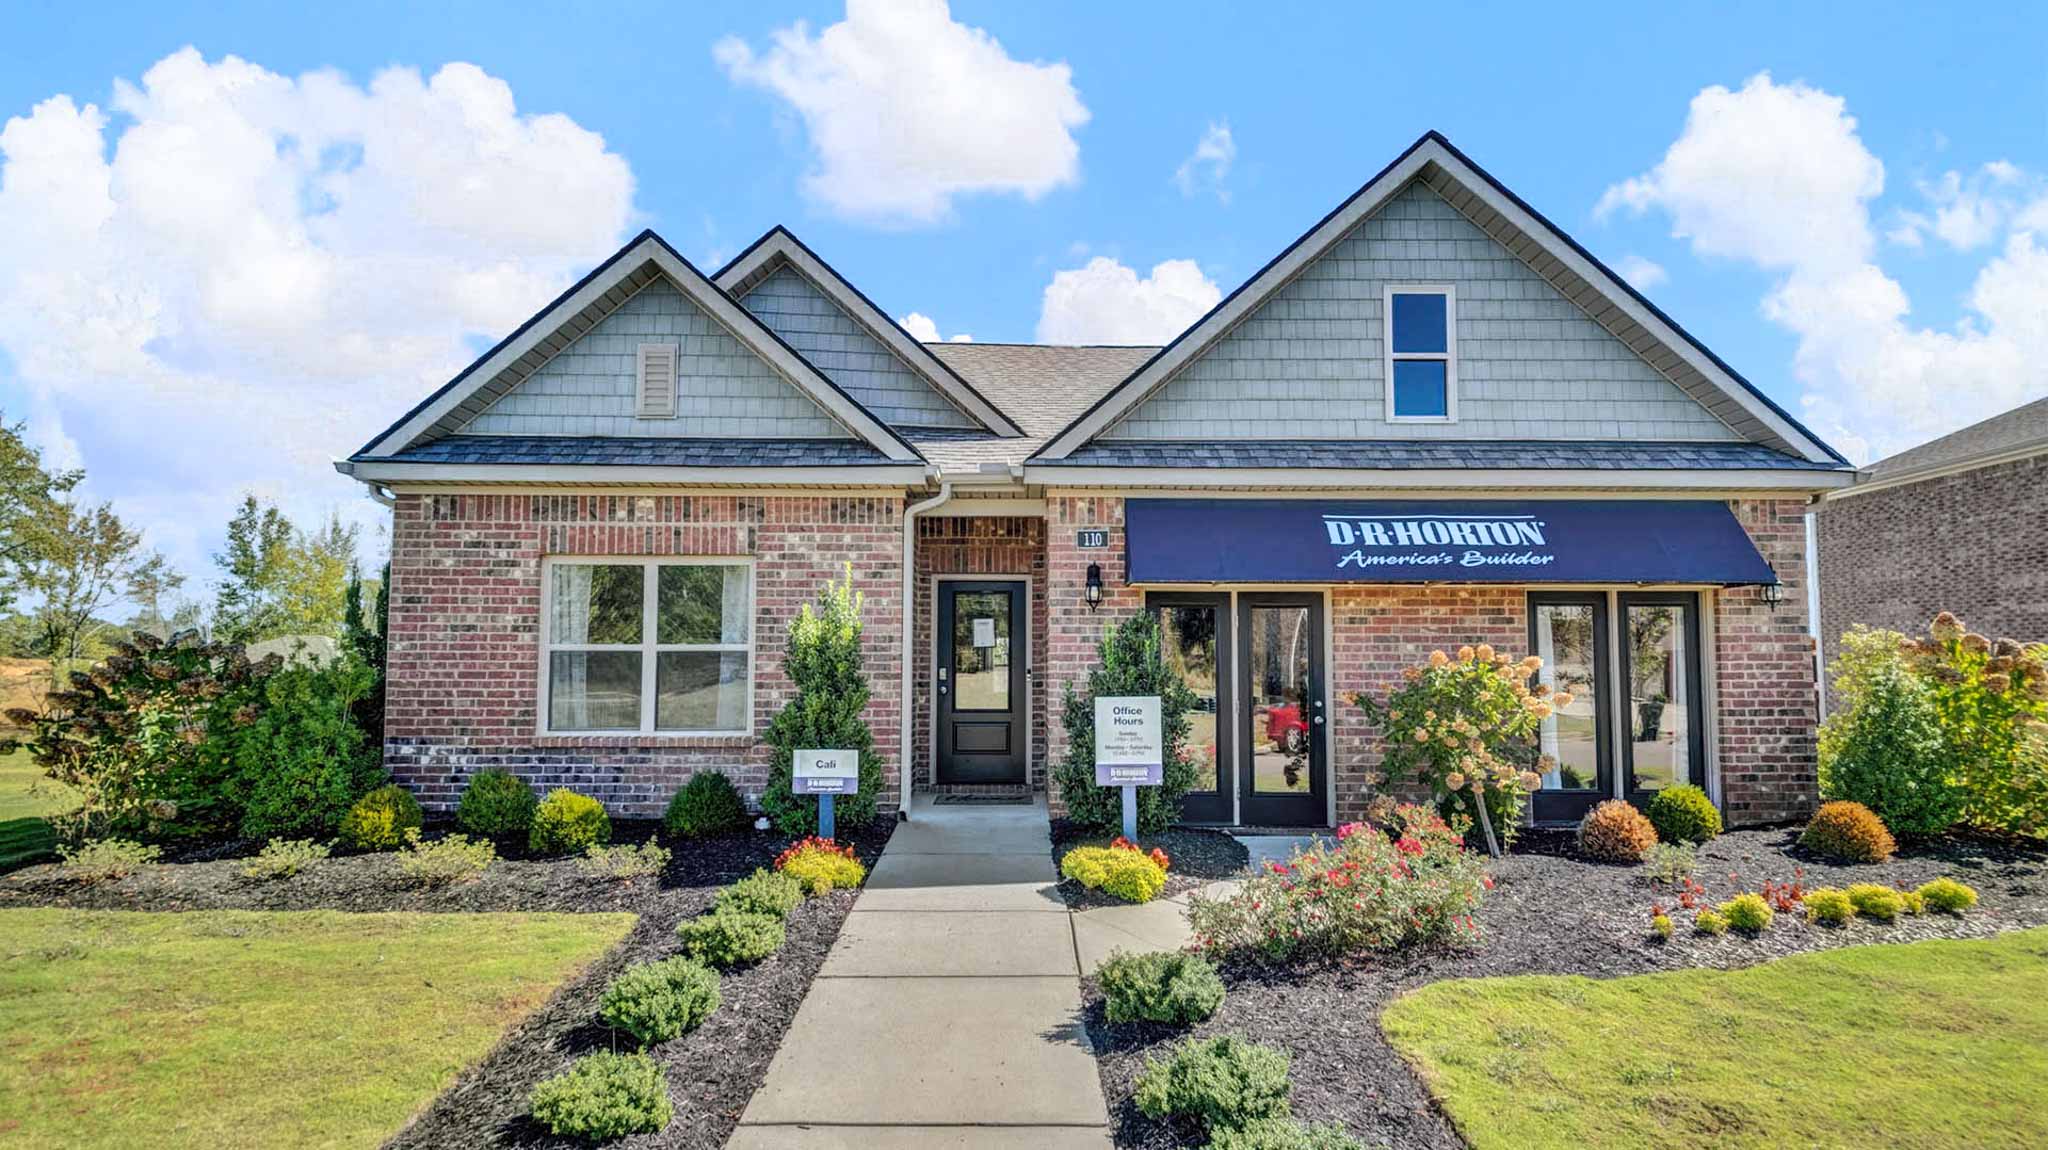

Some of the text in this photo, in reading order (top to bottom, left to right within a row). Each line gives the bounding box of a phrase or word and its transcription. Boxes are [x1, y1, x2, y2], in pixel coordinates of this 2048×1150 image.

[1084, 533, 1102, 546] 110
[1336, 550, 1554, 567] America's Builder
[1113, 706, 1142, 715] Office
[1114, 717, 1143, 725] Hours
[816, 760, 836, 768] Cali
